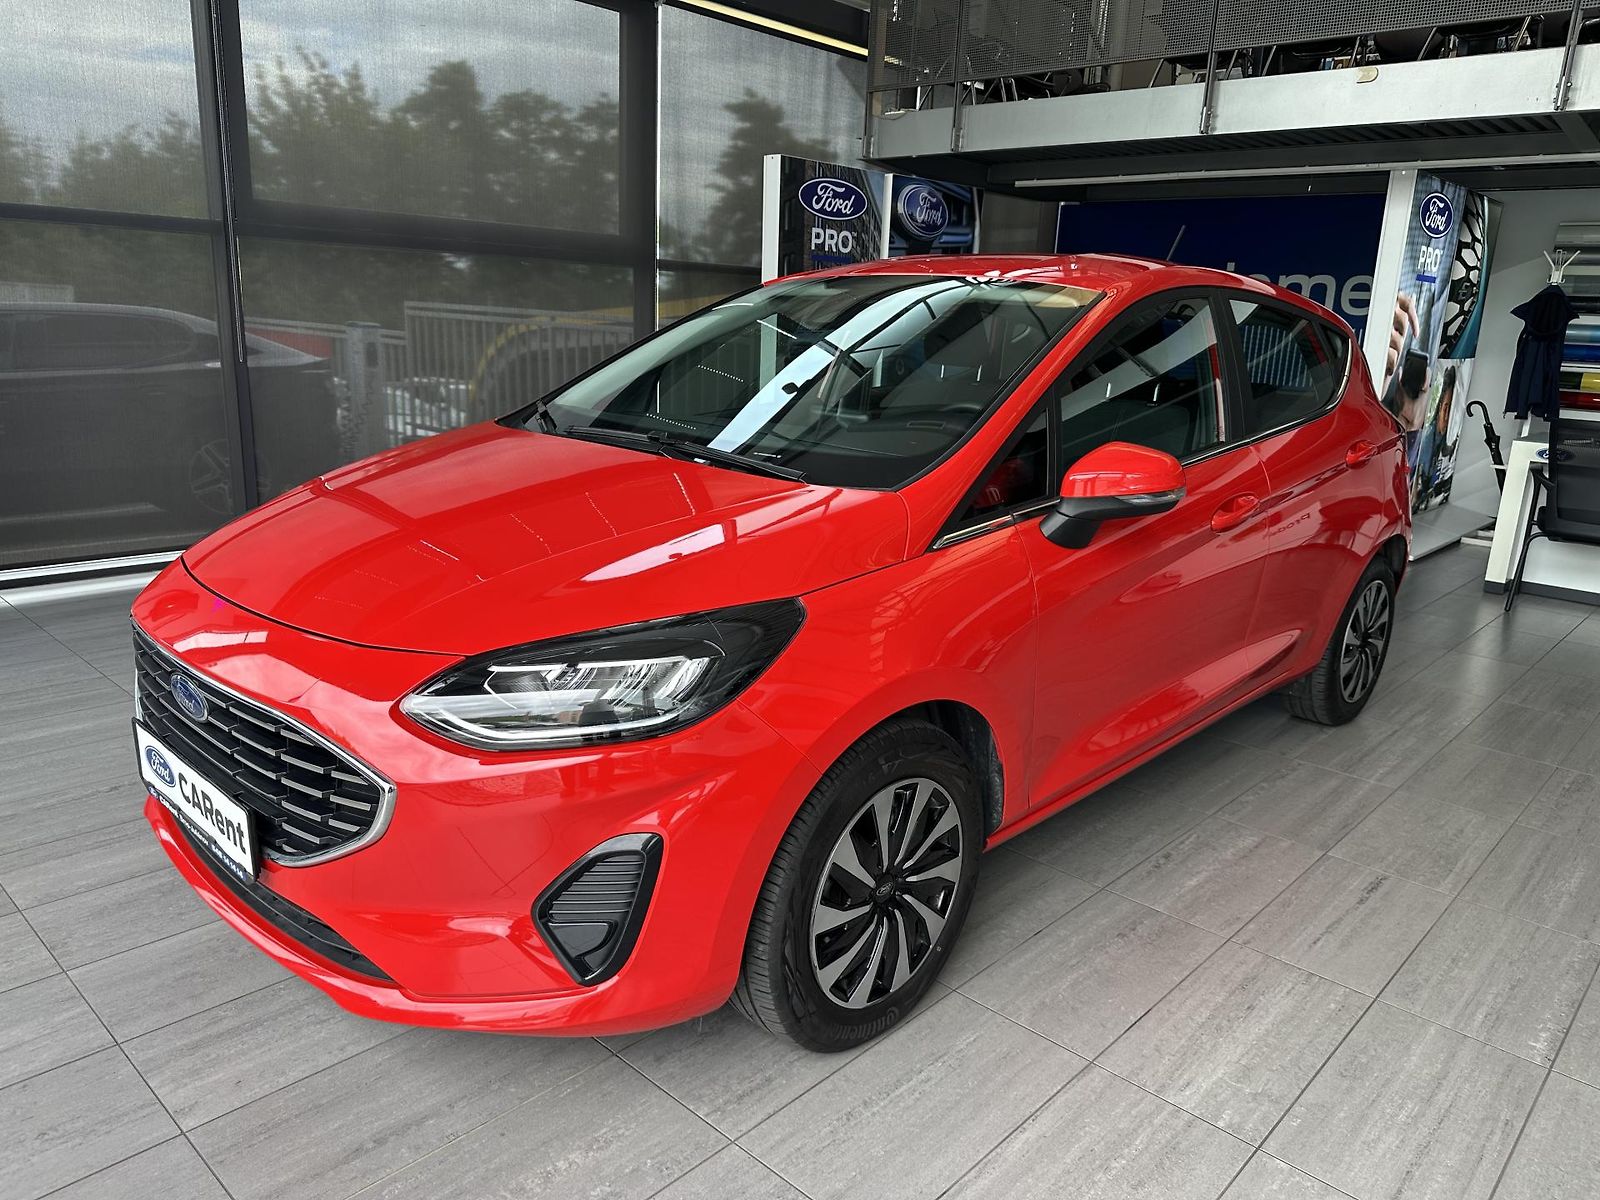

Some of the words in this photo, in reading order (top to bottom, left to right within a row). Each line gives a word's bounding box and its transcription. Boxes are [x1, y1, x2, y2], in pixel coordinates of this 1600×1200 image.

[812, 182, 856, 215] Ford
[916, 192, 943, 226] Ford
[1425, 198, 1448, 231] Ford
[178, 772, 247, 855] CARent
